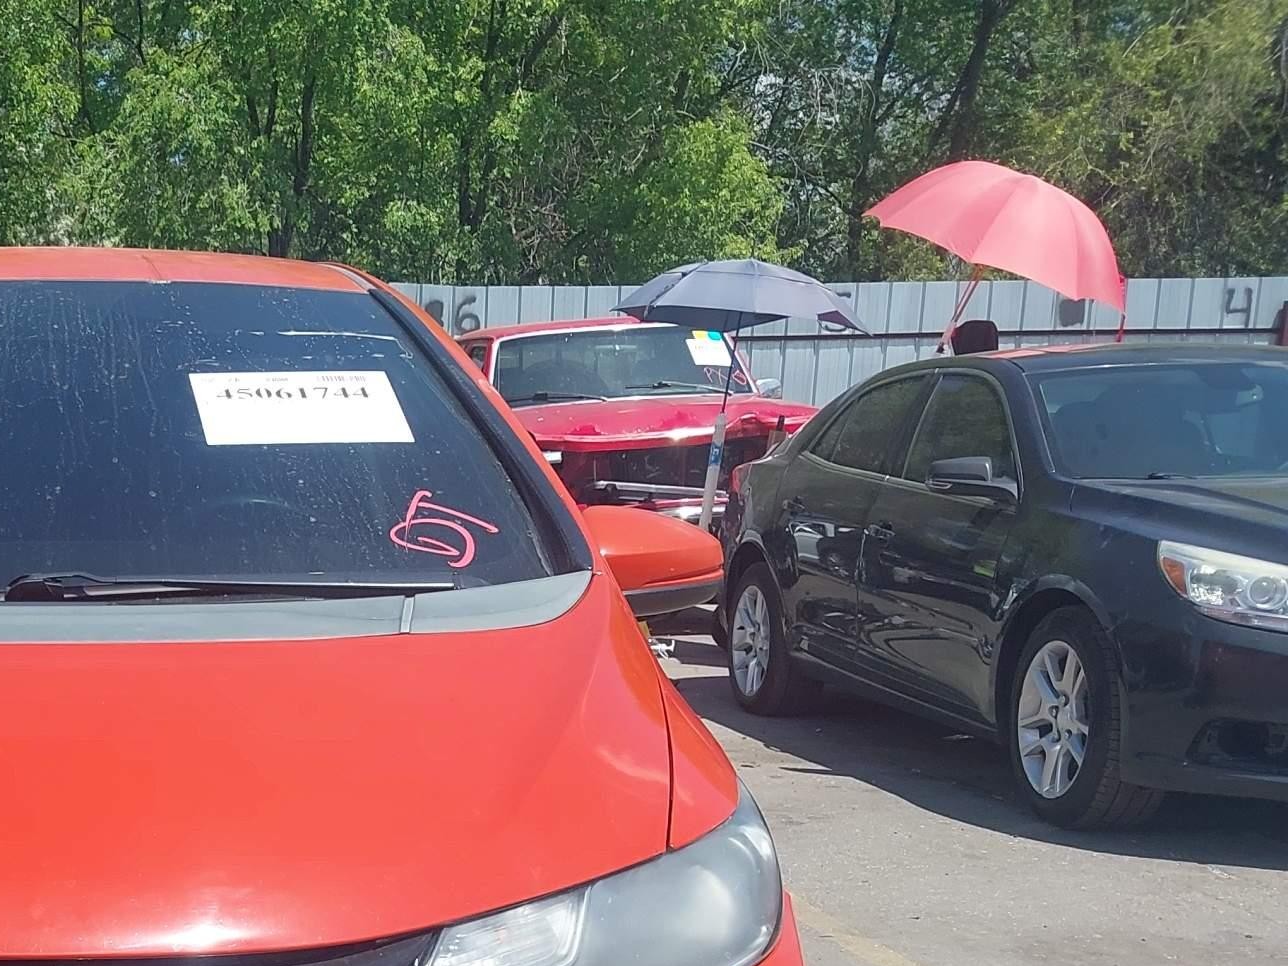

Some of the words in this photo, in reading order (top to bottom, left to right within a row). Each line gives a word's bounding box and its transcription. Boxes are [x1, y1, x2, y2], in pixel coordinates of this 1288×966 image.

[455, 295, 481, 336] 6
[1225, 287, 1253, 328] 4
[216, 387, 369, 400] 45061744
